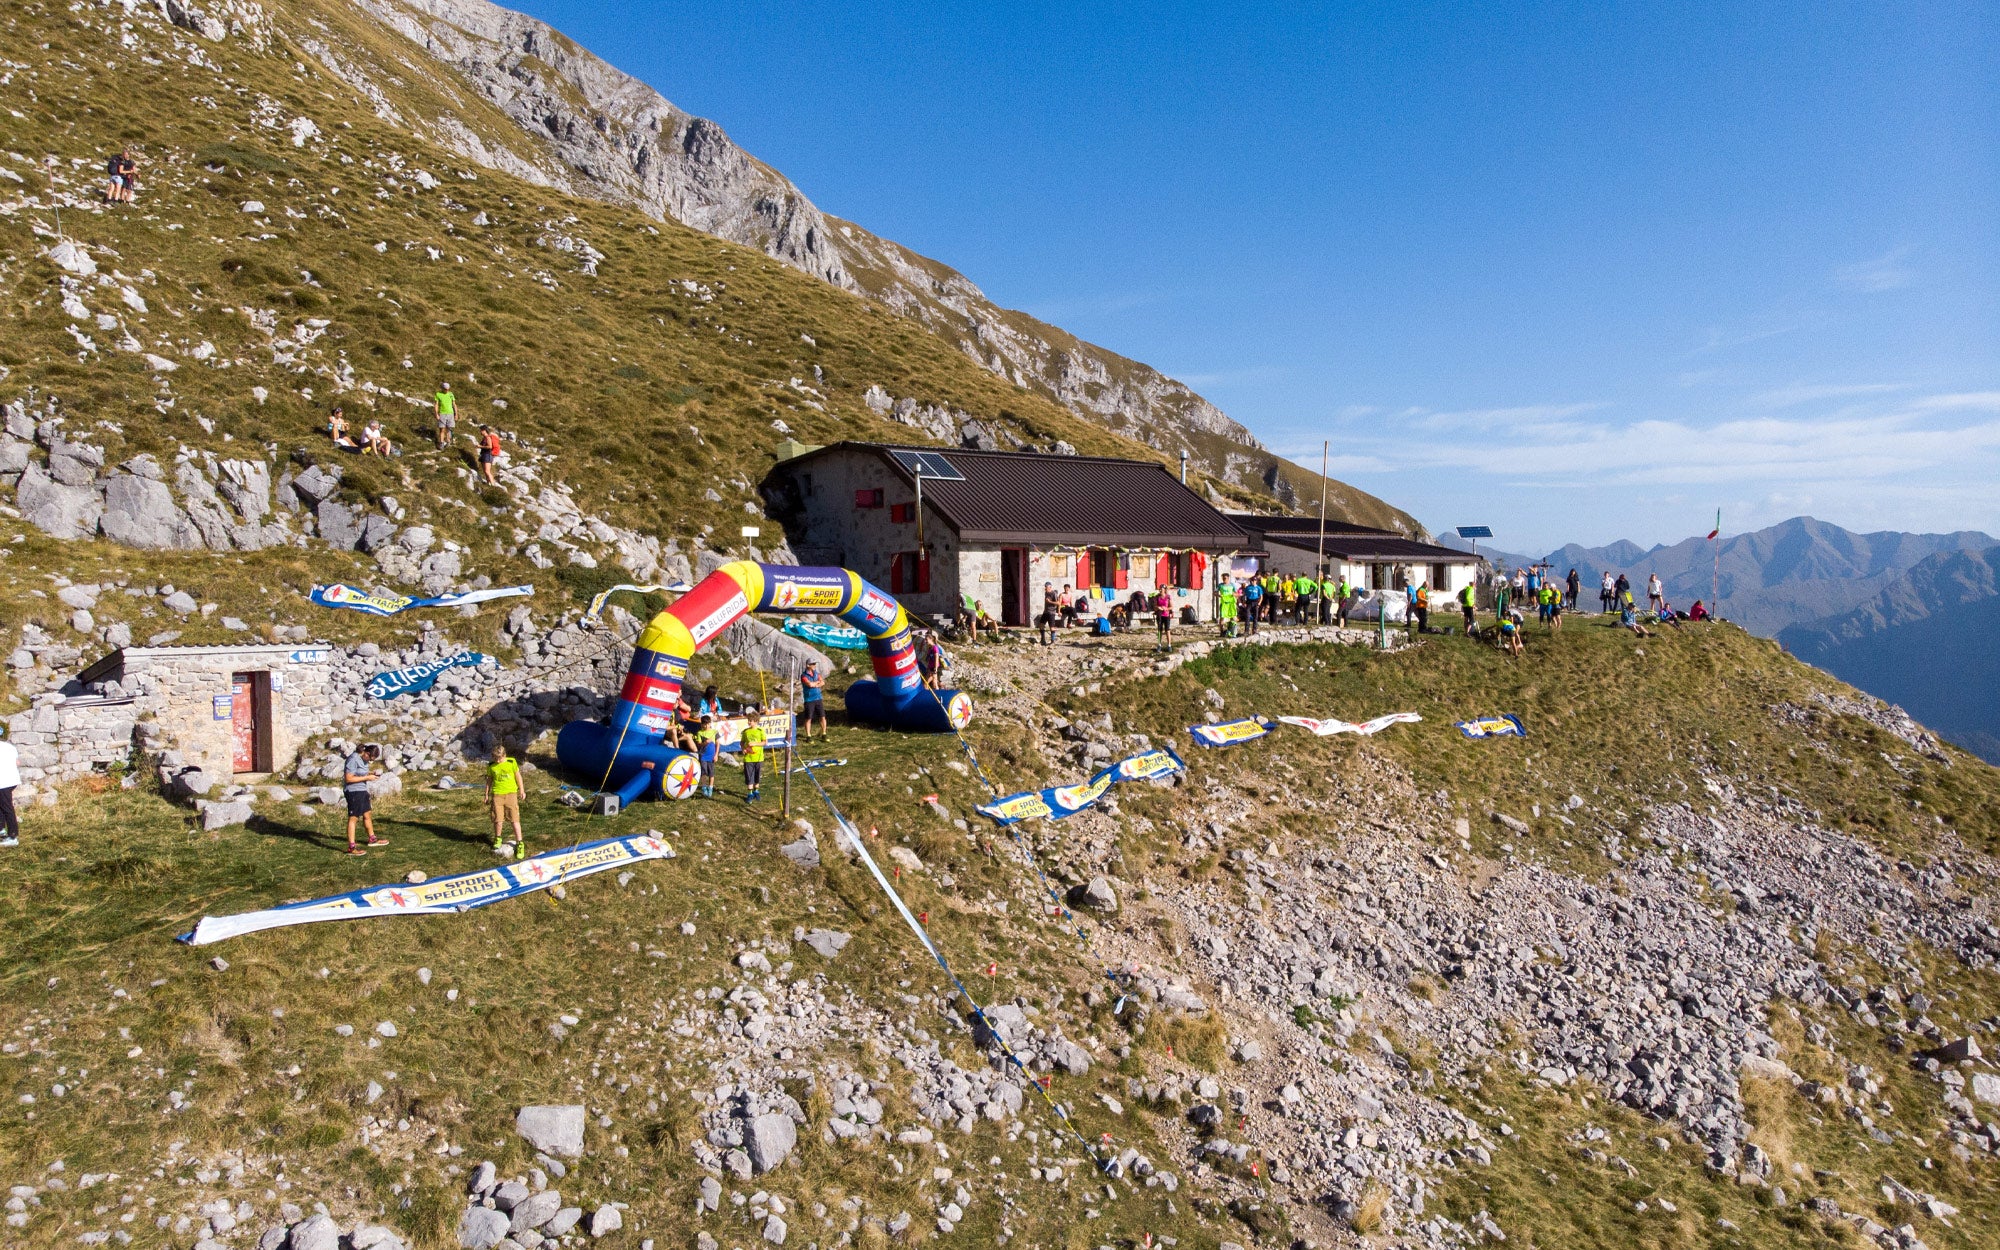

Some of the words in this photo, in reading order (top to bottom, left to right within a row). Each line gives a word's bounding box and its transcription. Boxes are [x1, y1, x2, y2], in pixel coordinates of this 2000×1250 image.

[814, 590, 840, 598] SPORT
[707, 596, 745, 629] BLUFRIDA
[445, 874, 496, 890] SPORT
[424, 881, 500, 902] SPECIALIST
